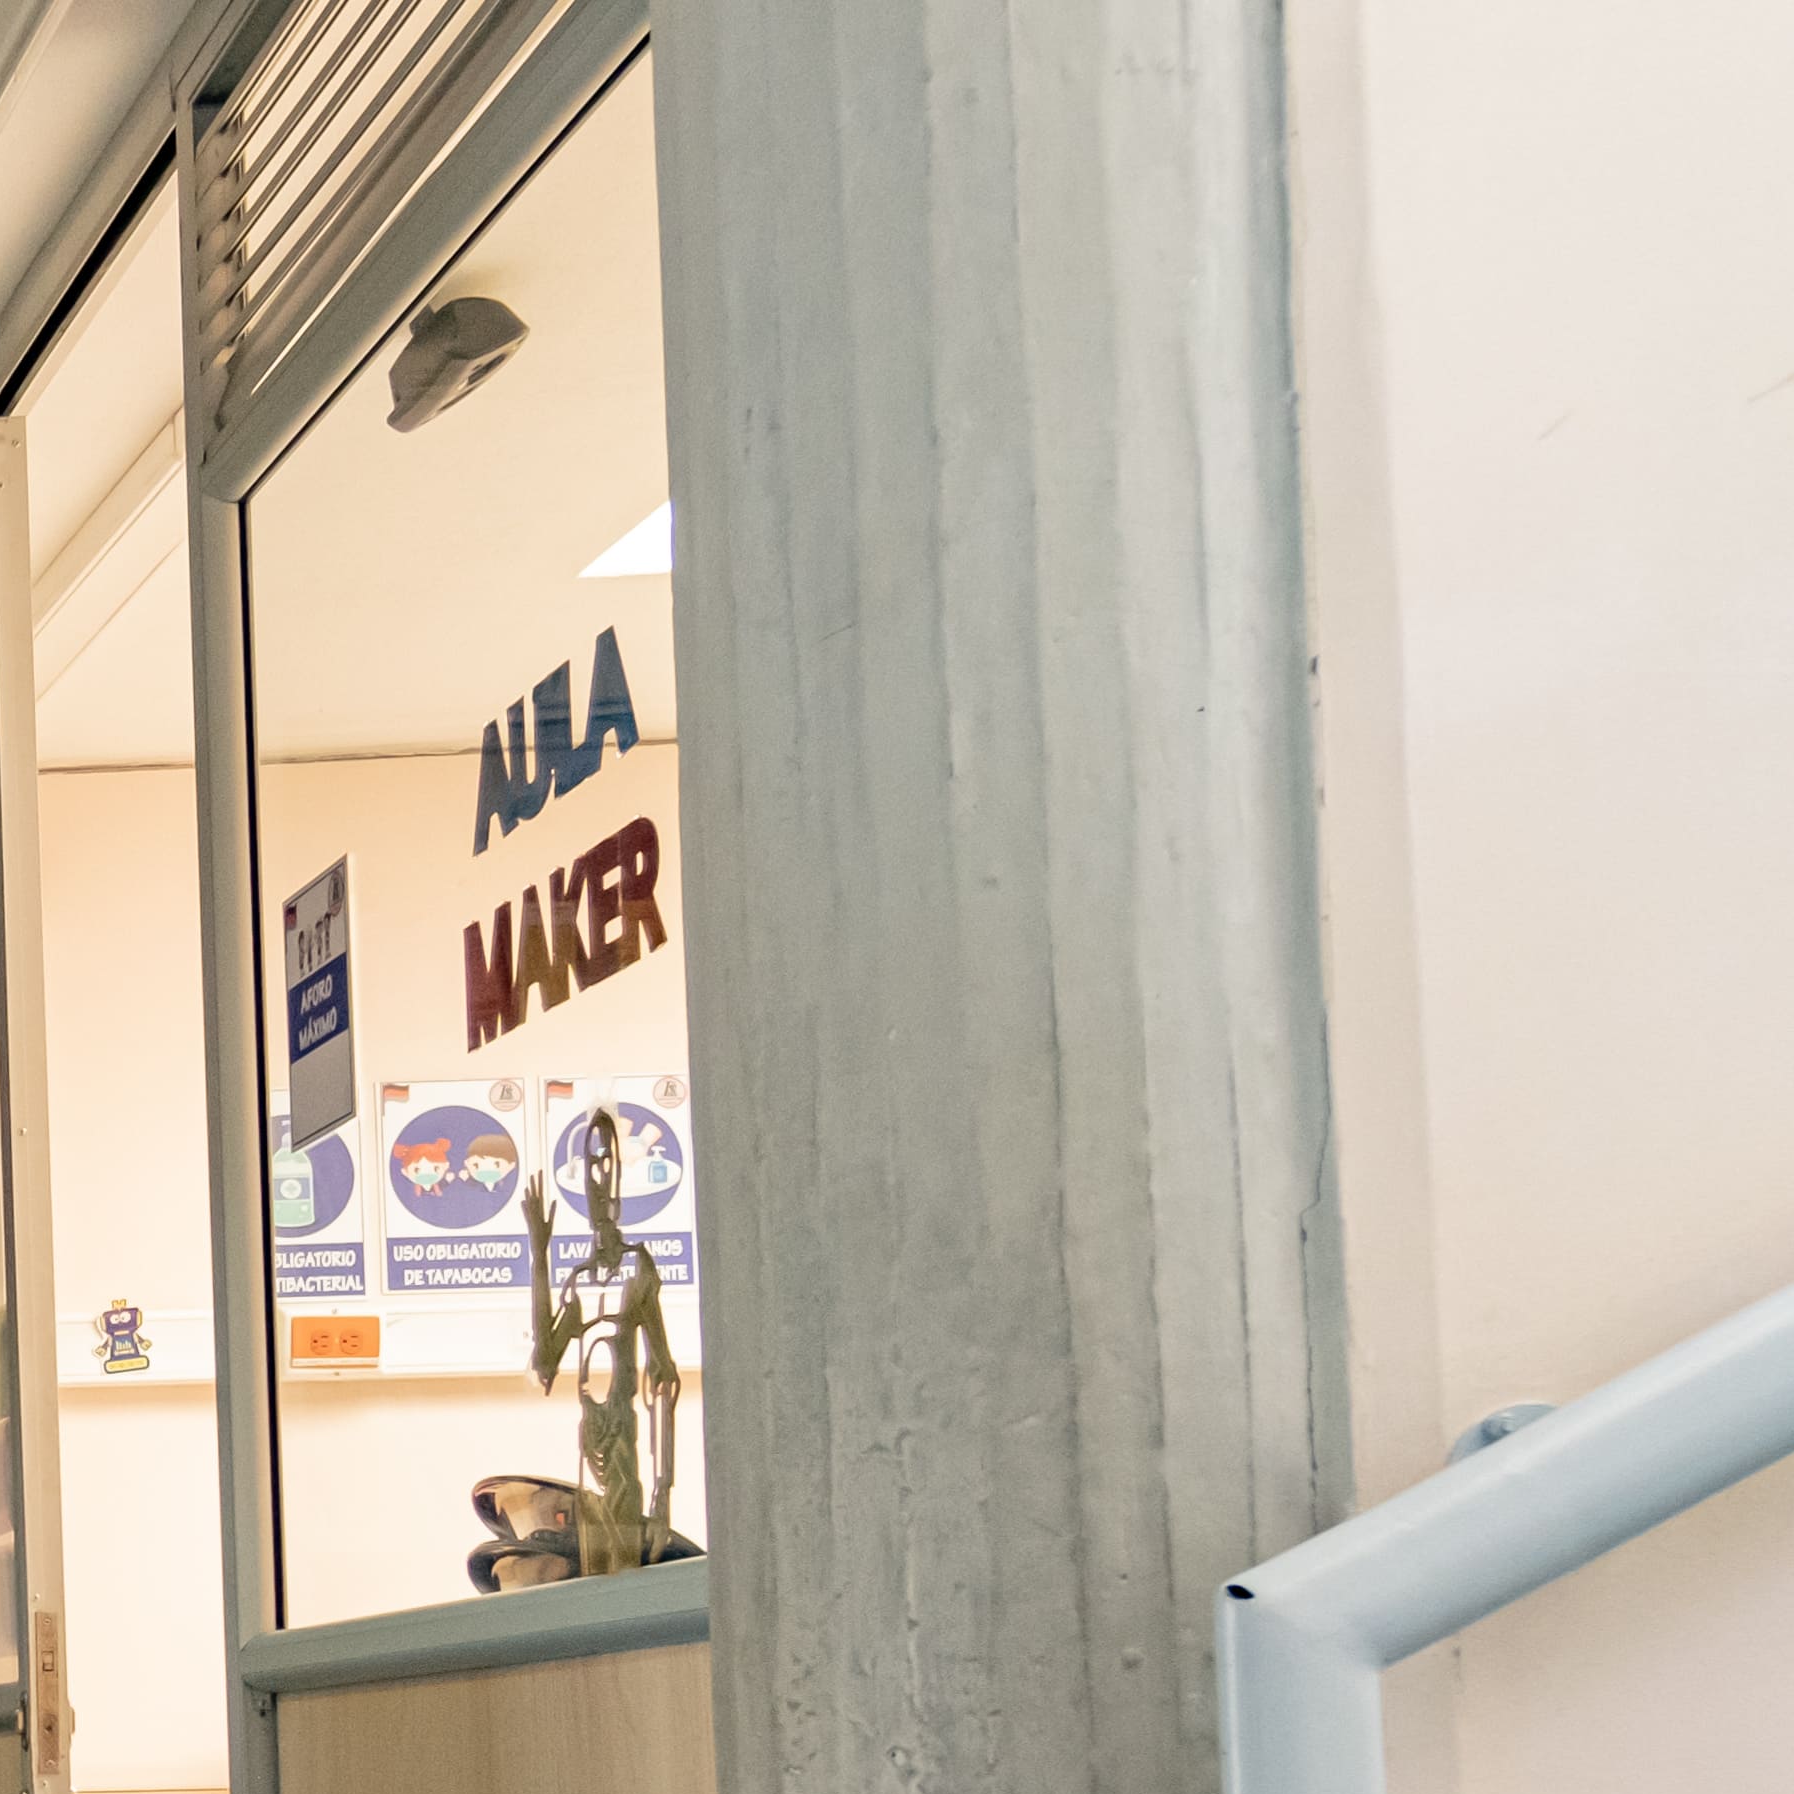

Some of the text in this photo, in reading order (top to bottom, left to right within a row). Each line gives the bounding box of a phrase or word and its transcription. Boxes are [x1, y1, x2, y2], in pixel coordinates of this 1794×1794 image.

[473, 626, 640, 856] AULA
[464, 816, 668, 1053] MAKER
[300, 973, 333, 1014] AFORO
[298, 1005, 338, 1051] MÁXIMO
[394, 1242, 521, 1261] USO OBLIGATORIO
[276, 1275, 364, 1293] TIBACTERIAL
[404, 1267, 512, 1286] DE TAPABOCAS
